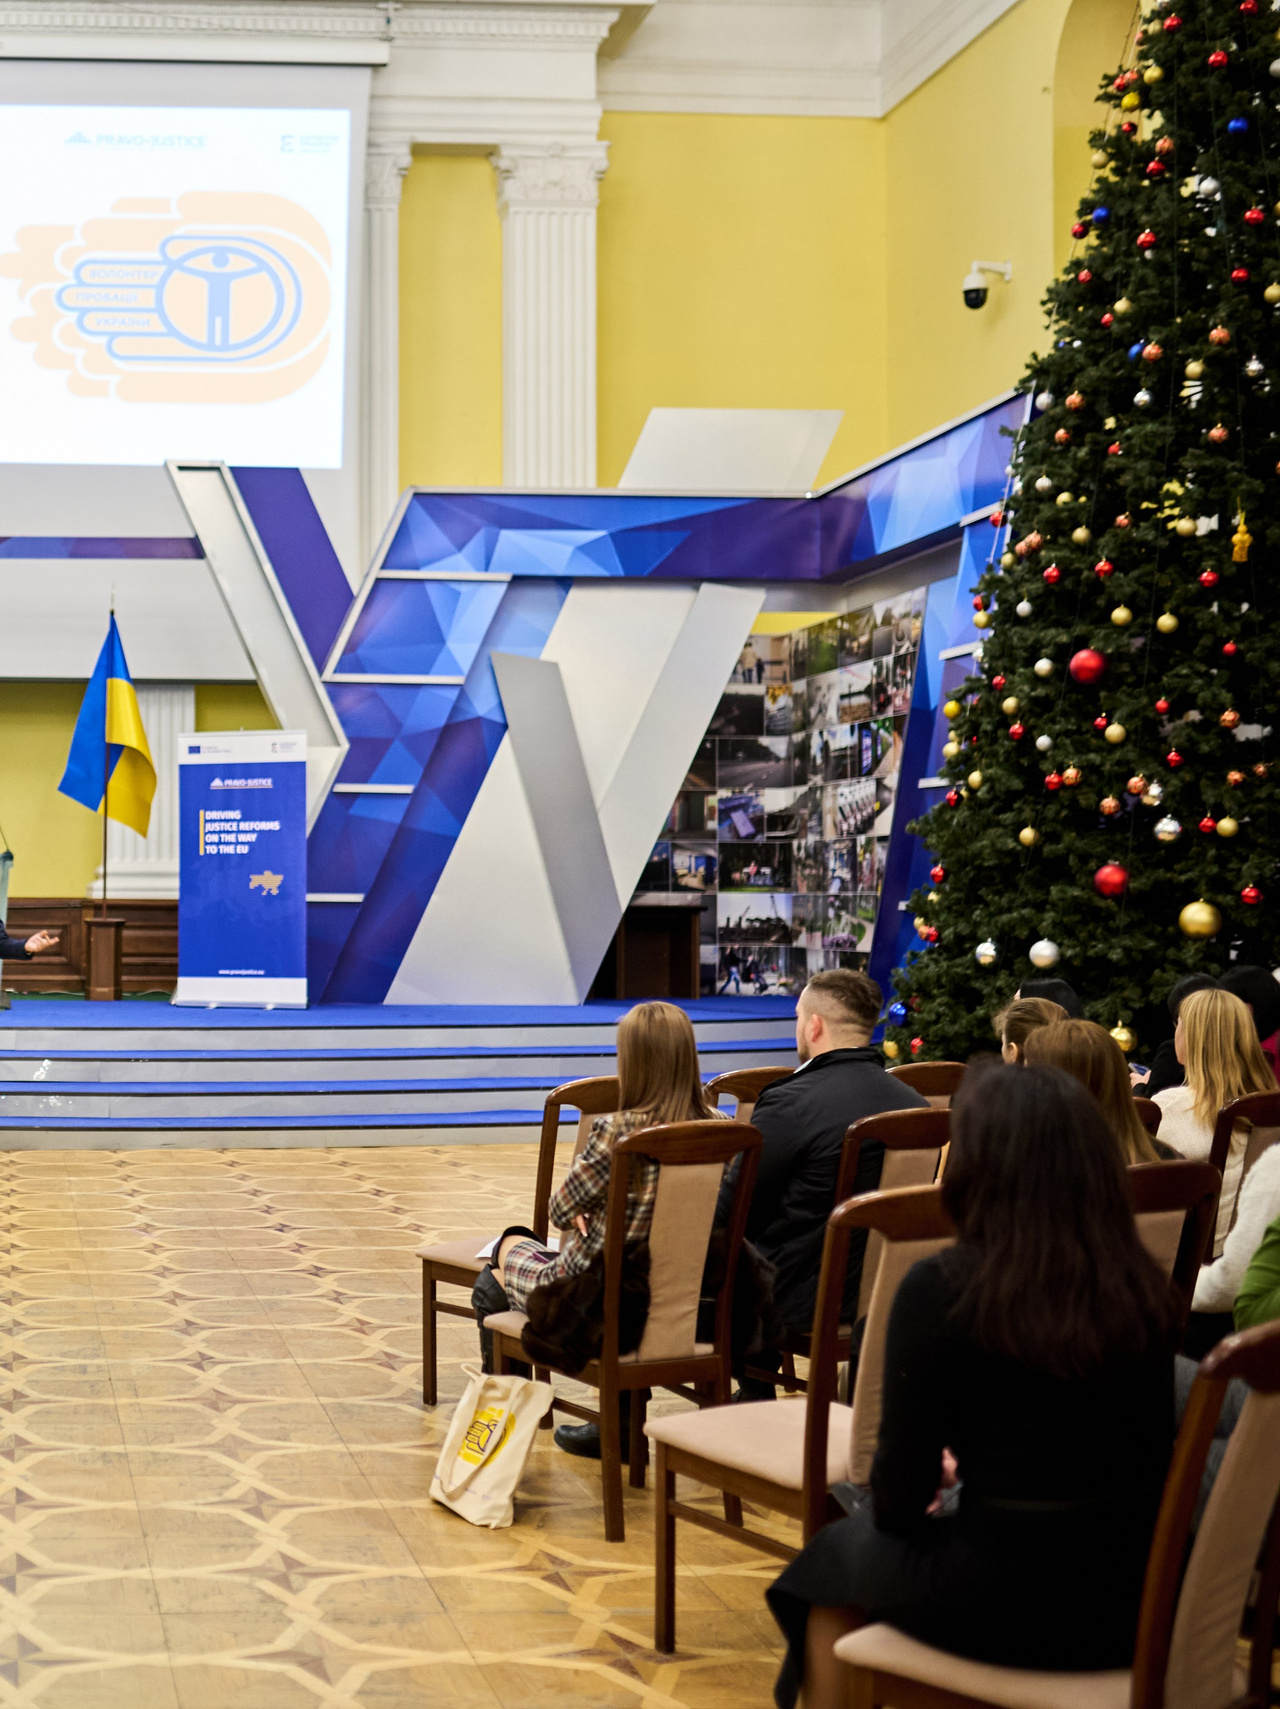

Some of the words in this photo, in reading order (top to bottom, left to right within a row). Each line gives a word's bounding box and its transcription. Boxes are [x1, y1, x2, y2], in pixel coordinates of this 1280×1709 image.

[96, 133, 206, 148] PRAVO-JUSTICE
[89, 269, 158, 279] ВОЛОНТЕР
[95, 317, 151, 327] УКРАЇНИ
[205, 810, 242, 820] DRIVING
[205, 821, 238, 832] JUSTICE
[239, 820, 280, 831] REFORMS
[205, 833, 219, 843] ON
[220, 833, 237, 843] THE
[238, 832, 258, 842] WAY
[205, 845, 218, 854] TO
[218, 845, 236, 854] THE
[236, 844, 249, 854] EU
